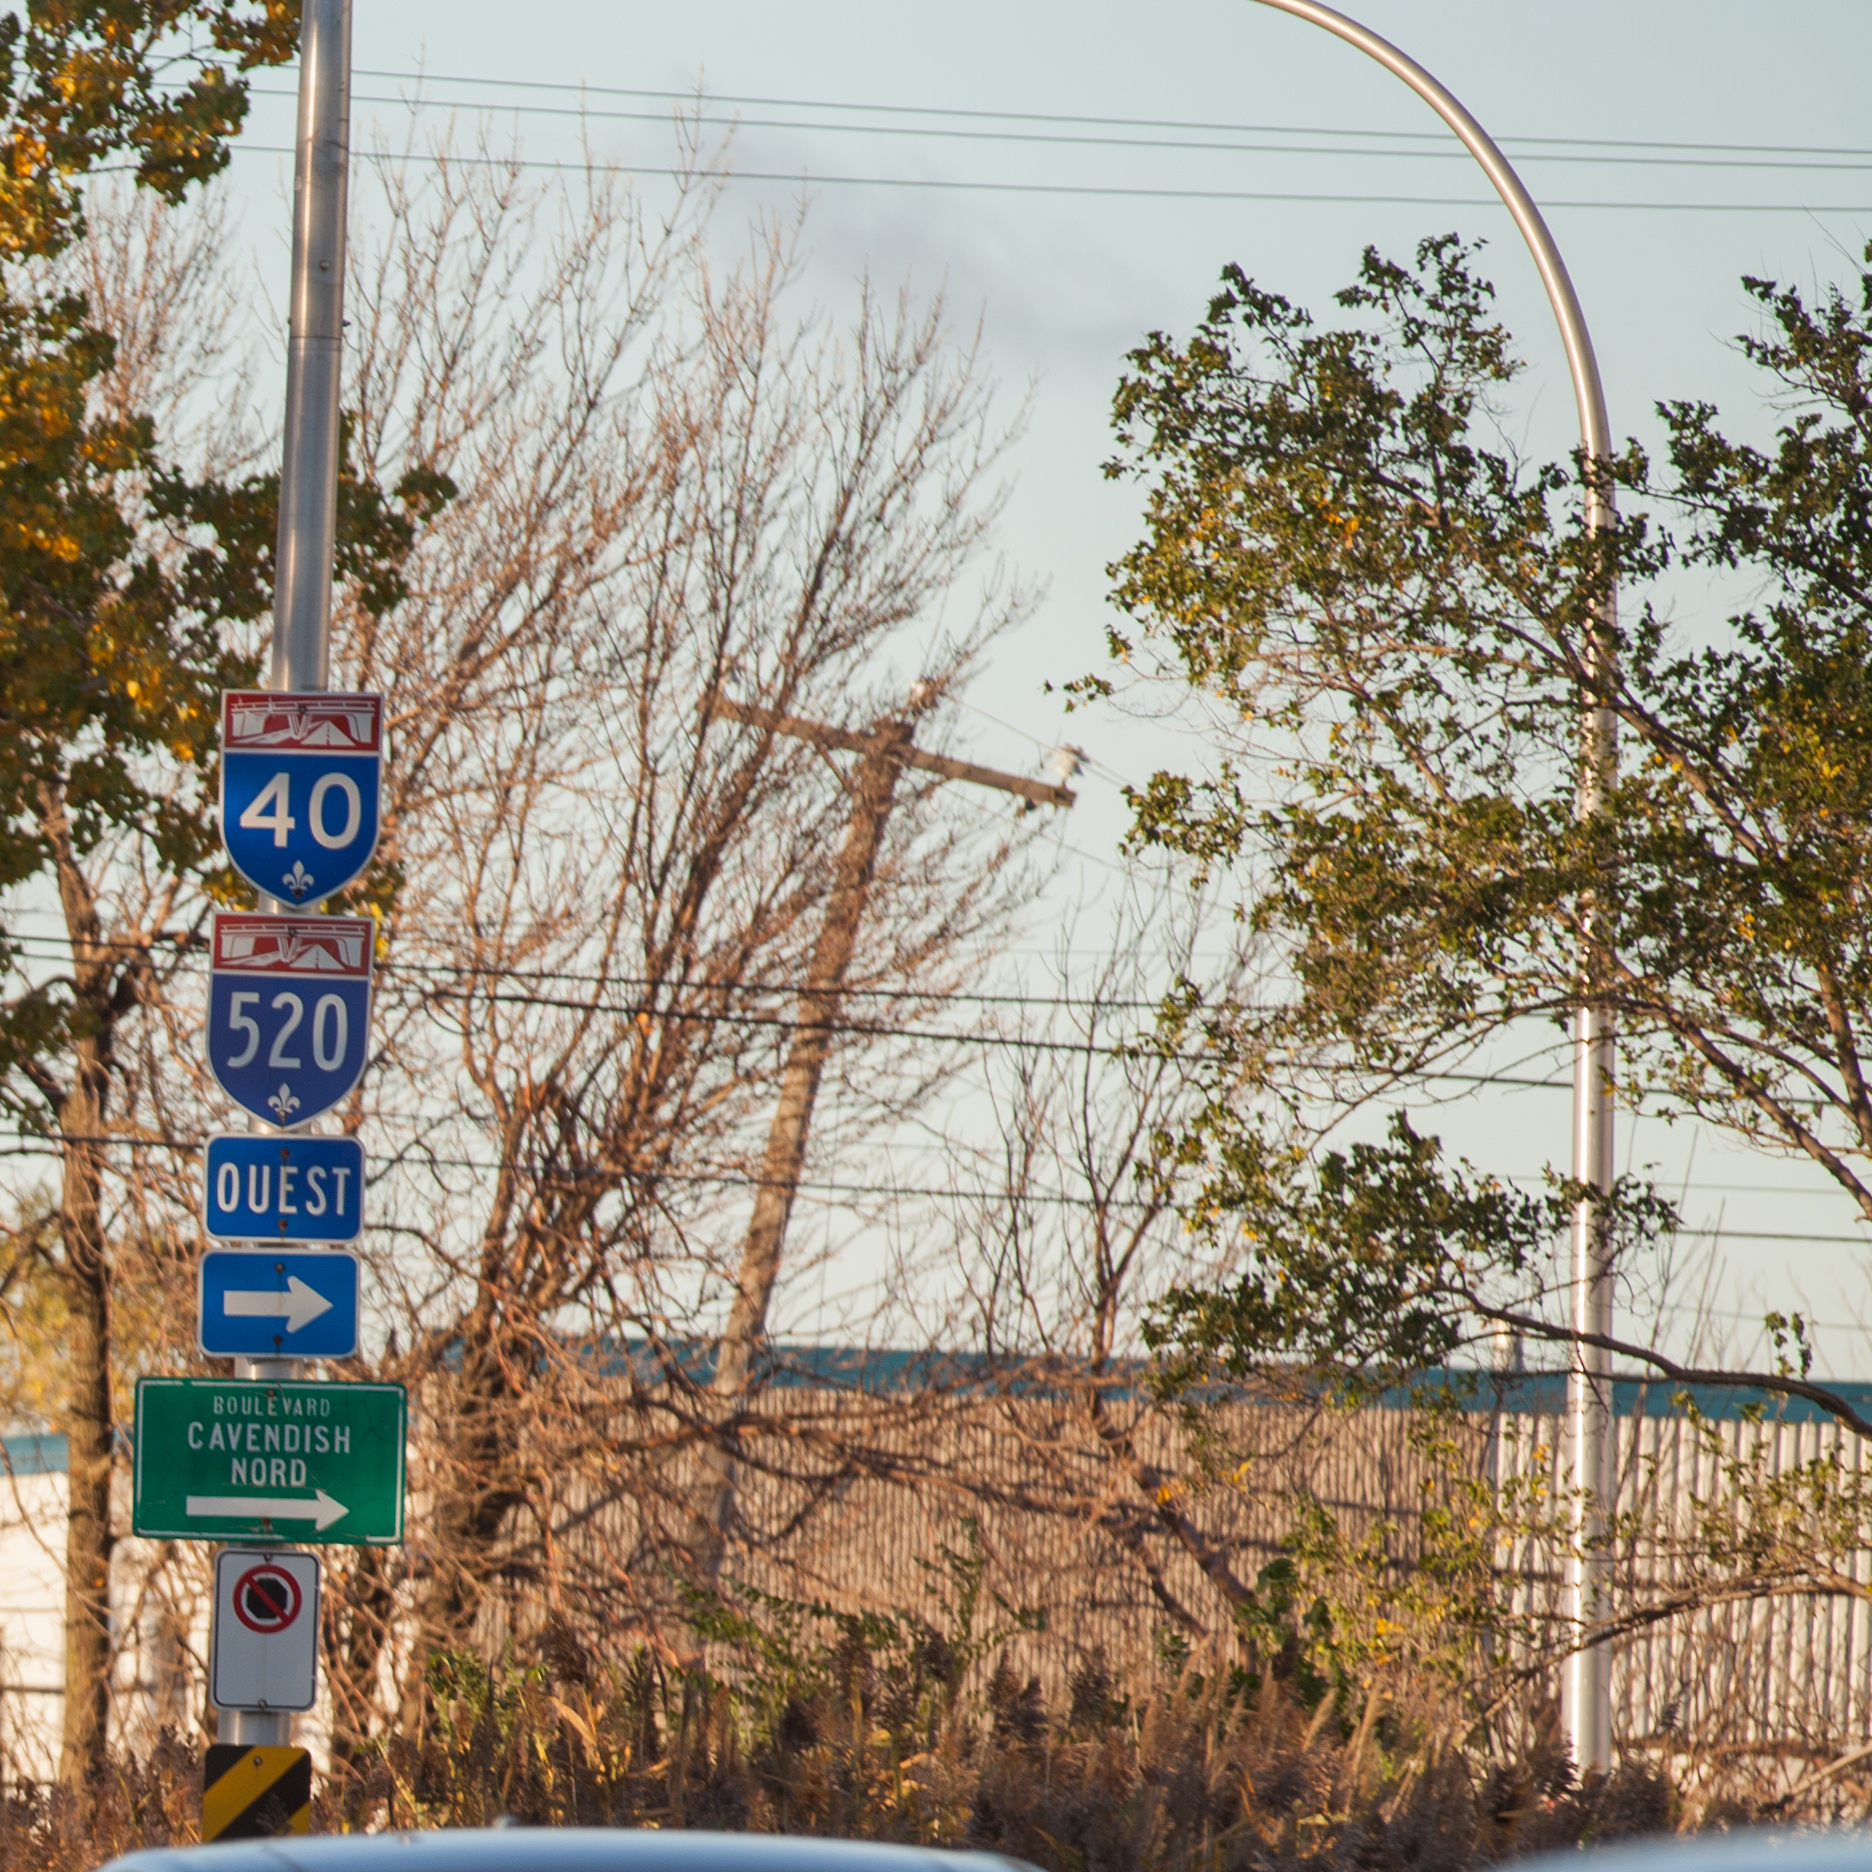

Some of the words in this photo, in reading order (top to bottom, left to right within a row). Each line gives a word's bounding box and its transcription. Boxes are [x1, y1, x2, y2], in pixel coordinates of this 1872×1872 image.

[239, 772, 361, 850] 40
[226, 991, 348, 1071] 520
[216, 1162, 351, 1217] OUEST
[213, 1395, 330, 1417] BOULEVARD
[187, 1421, 351, 1454] CAVENDISH
[230, 1457, 307, 1488] NORD
